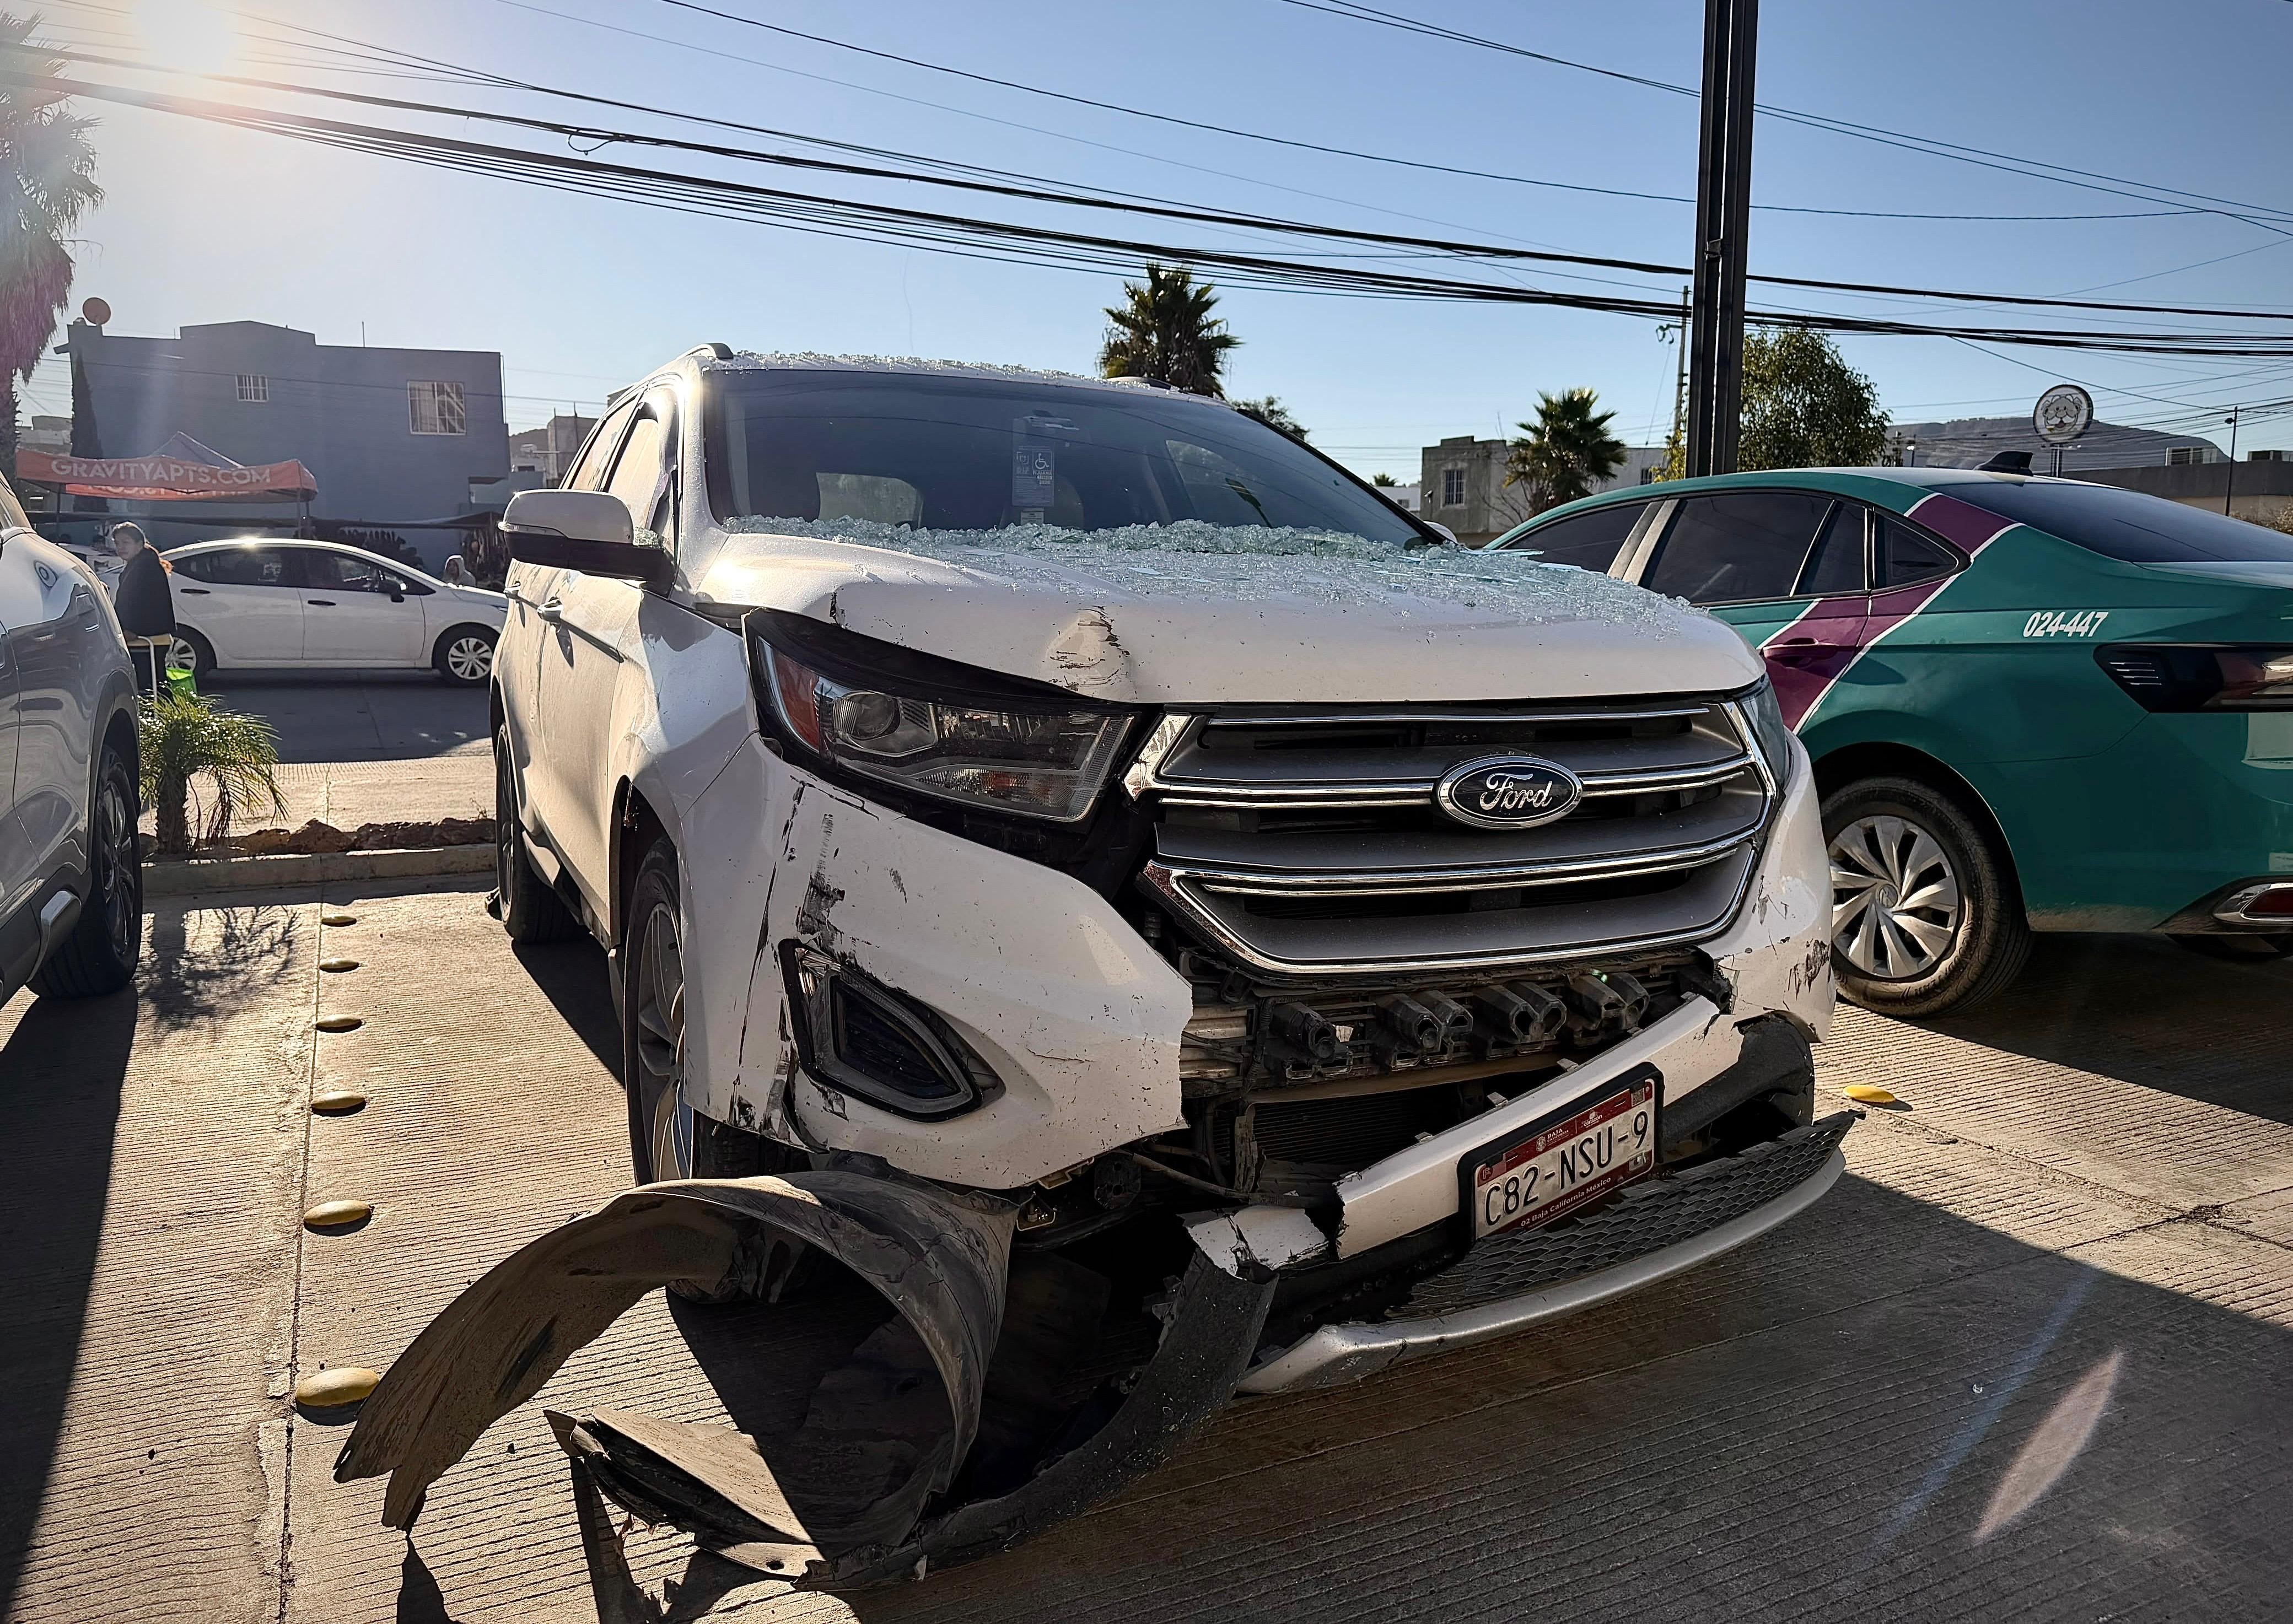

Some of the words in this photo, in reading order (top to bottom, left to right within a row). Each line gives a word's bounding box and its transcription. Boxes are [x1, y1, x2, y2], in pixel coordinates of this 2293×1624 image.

[51, 459, 270, 484] GRAVITYAPTS.COM
[2023, 611, 2108, 637] 024-447
[1480, 773, 1552, 811] Ford
[1547, 1128, 1563, 1139] BAJA
[1485, 1111, 1649, 1226] C82-NSU-9
[1532, 1210, 1548, 1222] Baja
[1550, 1191, 1585, 1212] California
[1586, 1177, 1611, 1194] México
